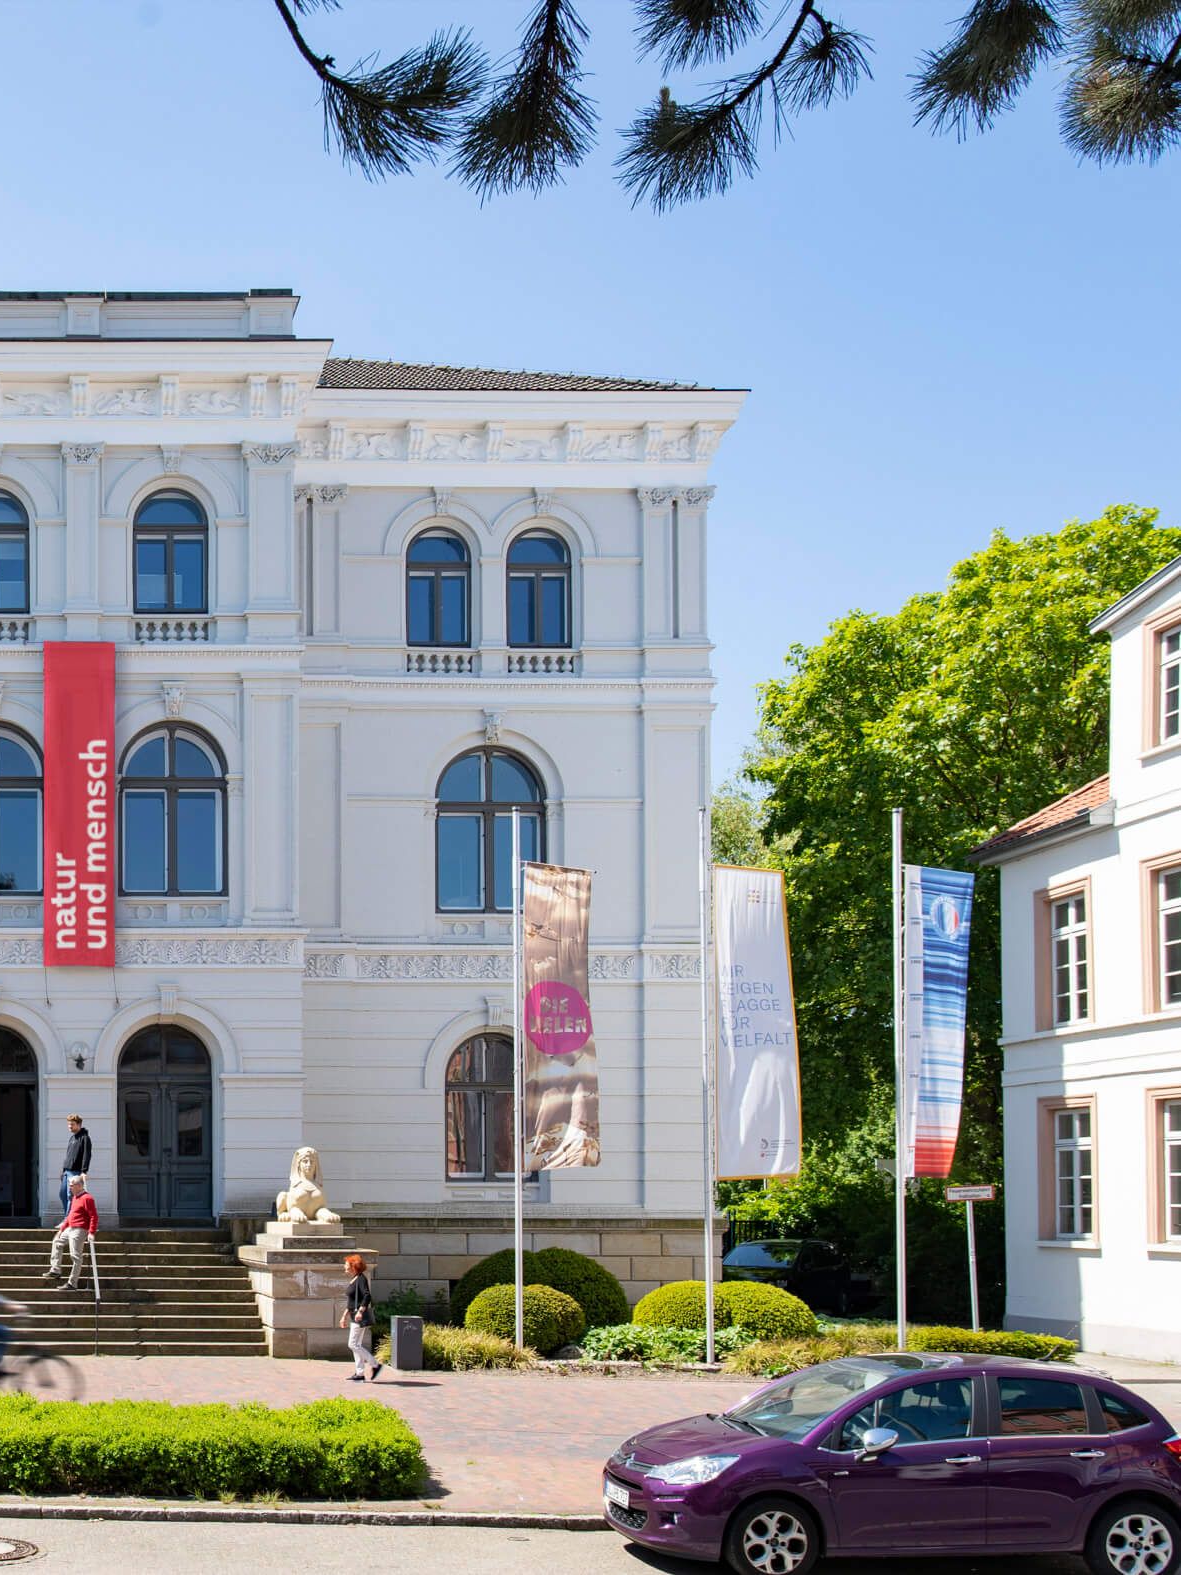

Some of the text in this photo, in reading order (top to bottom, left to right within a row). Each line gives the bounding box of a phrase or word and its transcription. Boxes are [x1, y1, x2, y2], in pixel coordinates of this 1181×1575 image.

[51, 852, 77, 949] natur
[78, 739, 107, 950] und mensch
